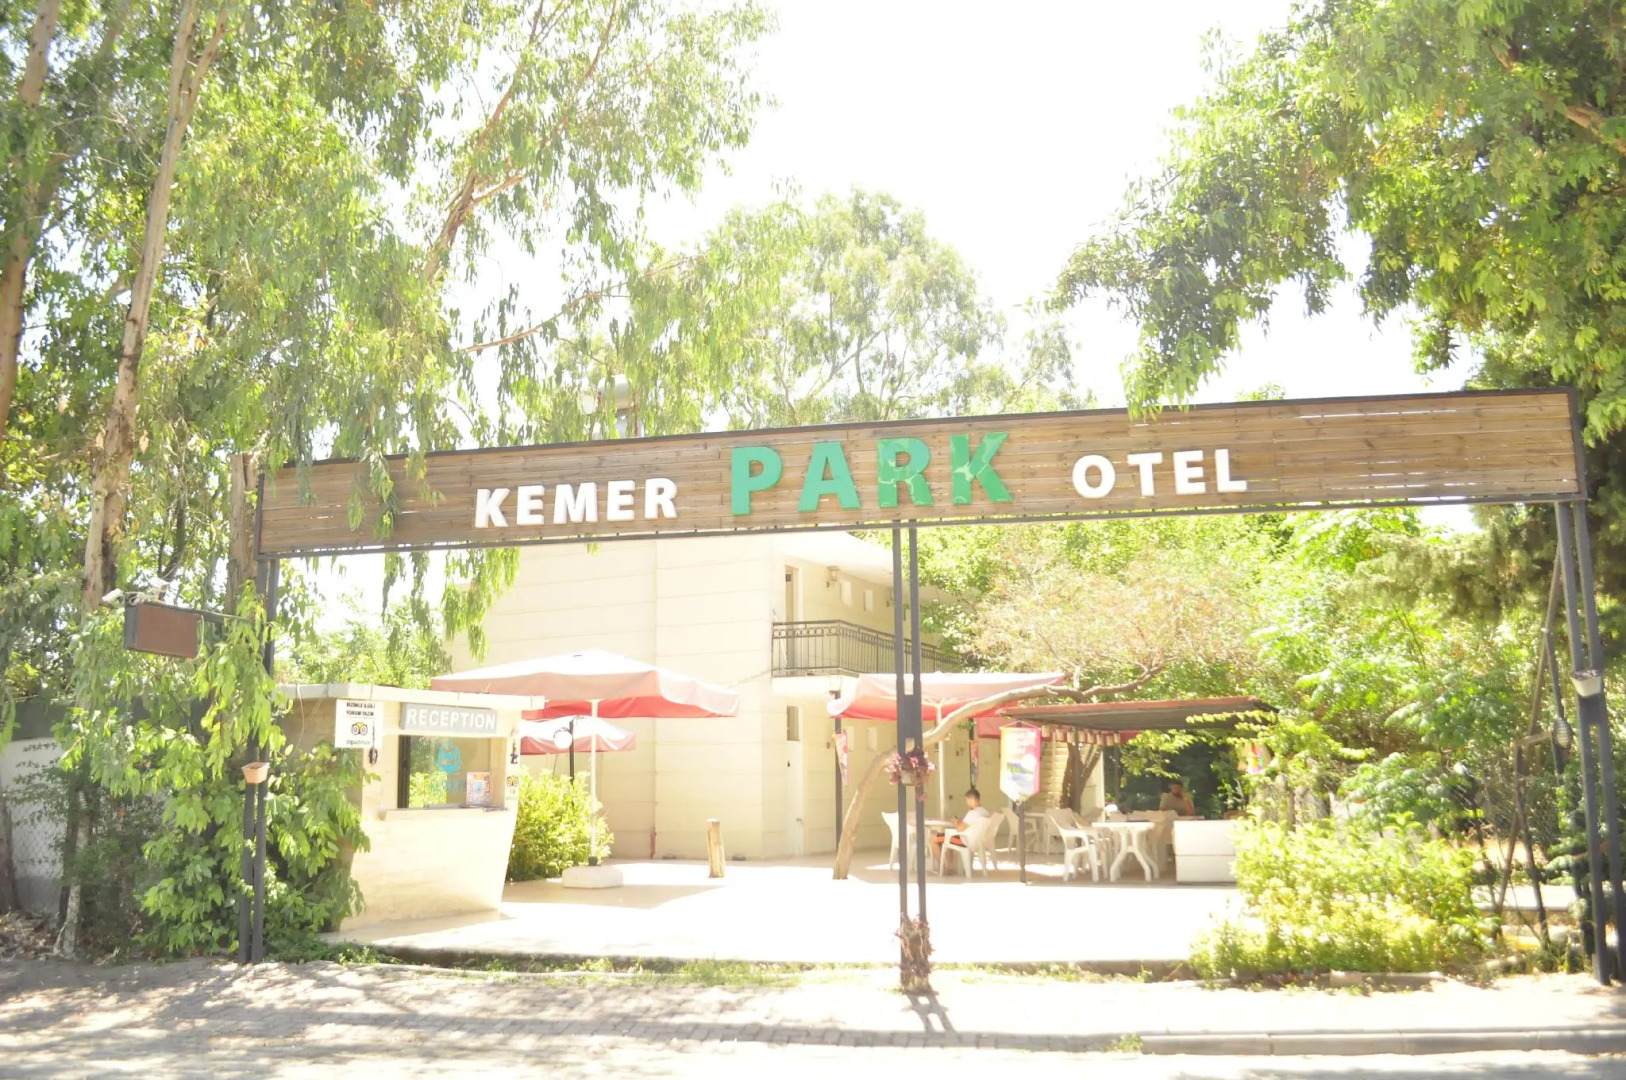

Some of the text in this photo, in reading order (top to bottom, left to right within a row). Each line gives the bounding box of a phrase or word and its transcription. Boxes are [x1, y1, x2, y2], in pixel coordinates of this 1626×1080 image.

[474, 431, 1248, 529] KEMER PARK OTEL
[405, 708, 497, 730] RECEPTION
